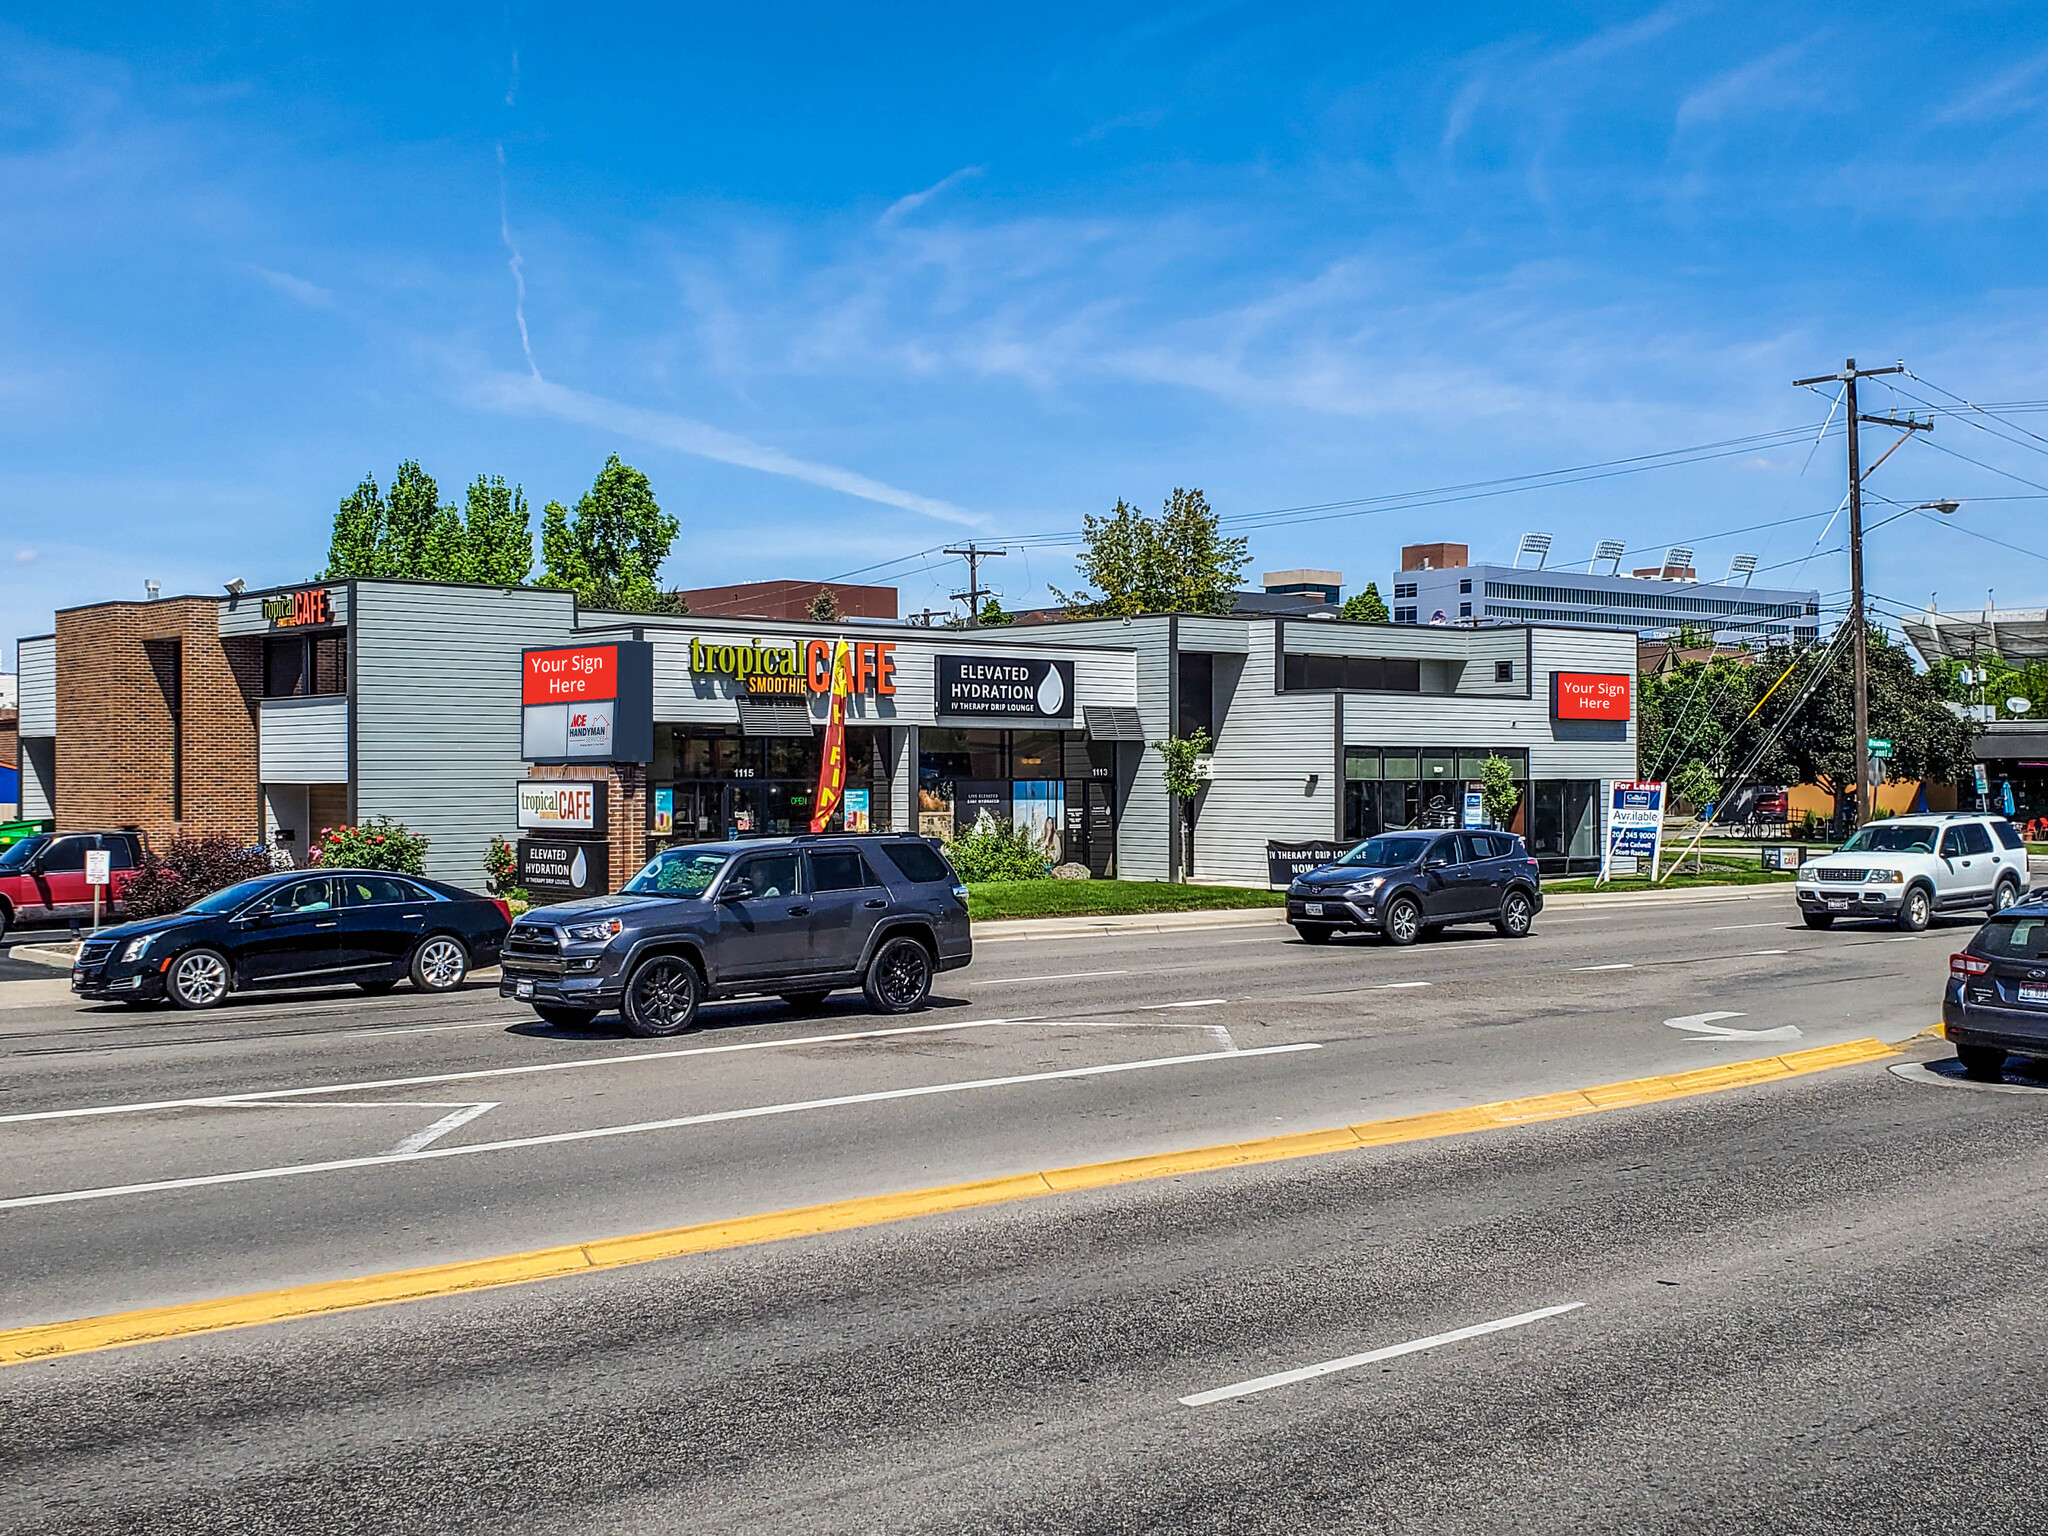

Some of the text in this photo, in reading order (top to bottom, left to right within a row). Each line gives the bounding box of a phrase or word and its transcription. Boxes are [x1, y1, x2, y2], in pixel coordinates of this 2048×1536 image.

[263, 590, 325, 625] ropical CAFE
[532, 655, 602, 674] Your Sign
[690, 637, 806, 681] tropical
[960, 665, 1029, 680] ELEVATED
[549, 679, 585, 694] Here
[749, 677, 807, 694] SMOOTHIE
[951, 683, 1034, 700] HYDRATION
[1564, 682, 1624, 697] Your Sign
[960, 702, 989, 710] THERAPY
[990, 703, 1006, 711] DRIP
[1007, 704, 1034, 712] LOUNGE
[1579, 697, 1610, 708] Here
[570, 713, 587, 727] ACE
[569, 726, 605, 738] HANDYMAN
[734, 769, 754, 778] 1115
[1092, 768, 1108, 776] 1113
[1614, 782, 1660, 791] For Lease
[522, 791, 591, 820] tropical CAFE
[791, 797, 807, 805] OPEN
[1613, 810, 1658, 822] Available
[1625, 831, 1637, 839] 345
[1639, 832, 1656, 840] 9000
[530, 848, 566, 860] ELEVATED
[1269, 851, 1367, 860] IV THERAPY DRIP LOGE
[525, 863, 569, 876] HYDRATION
[1291, 864, 1314, 874] NOW
